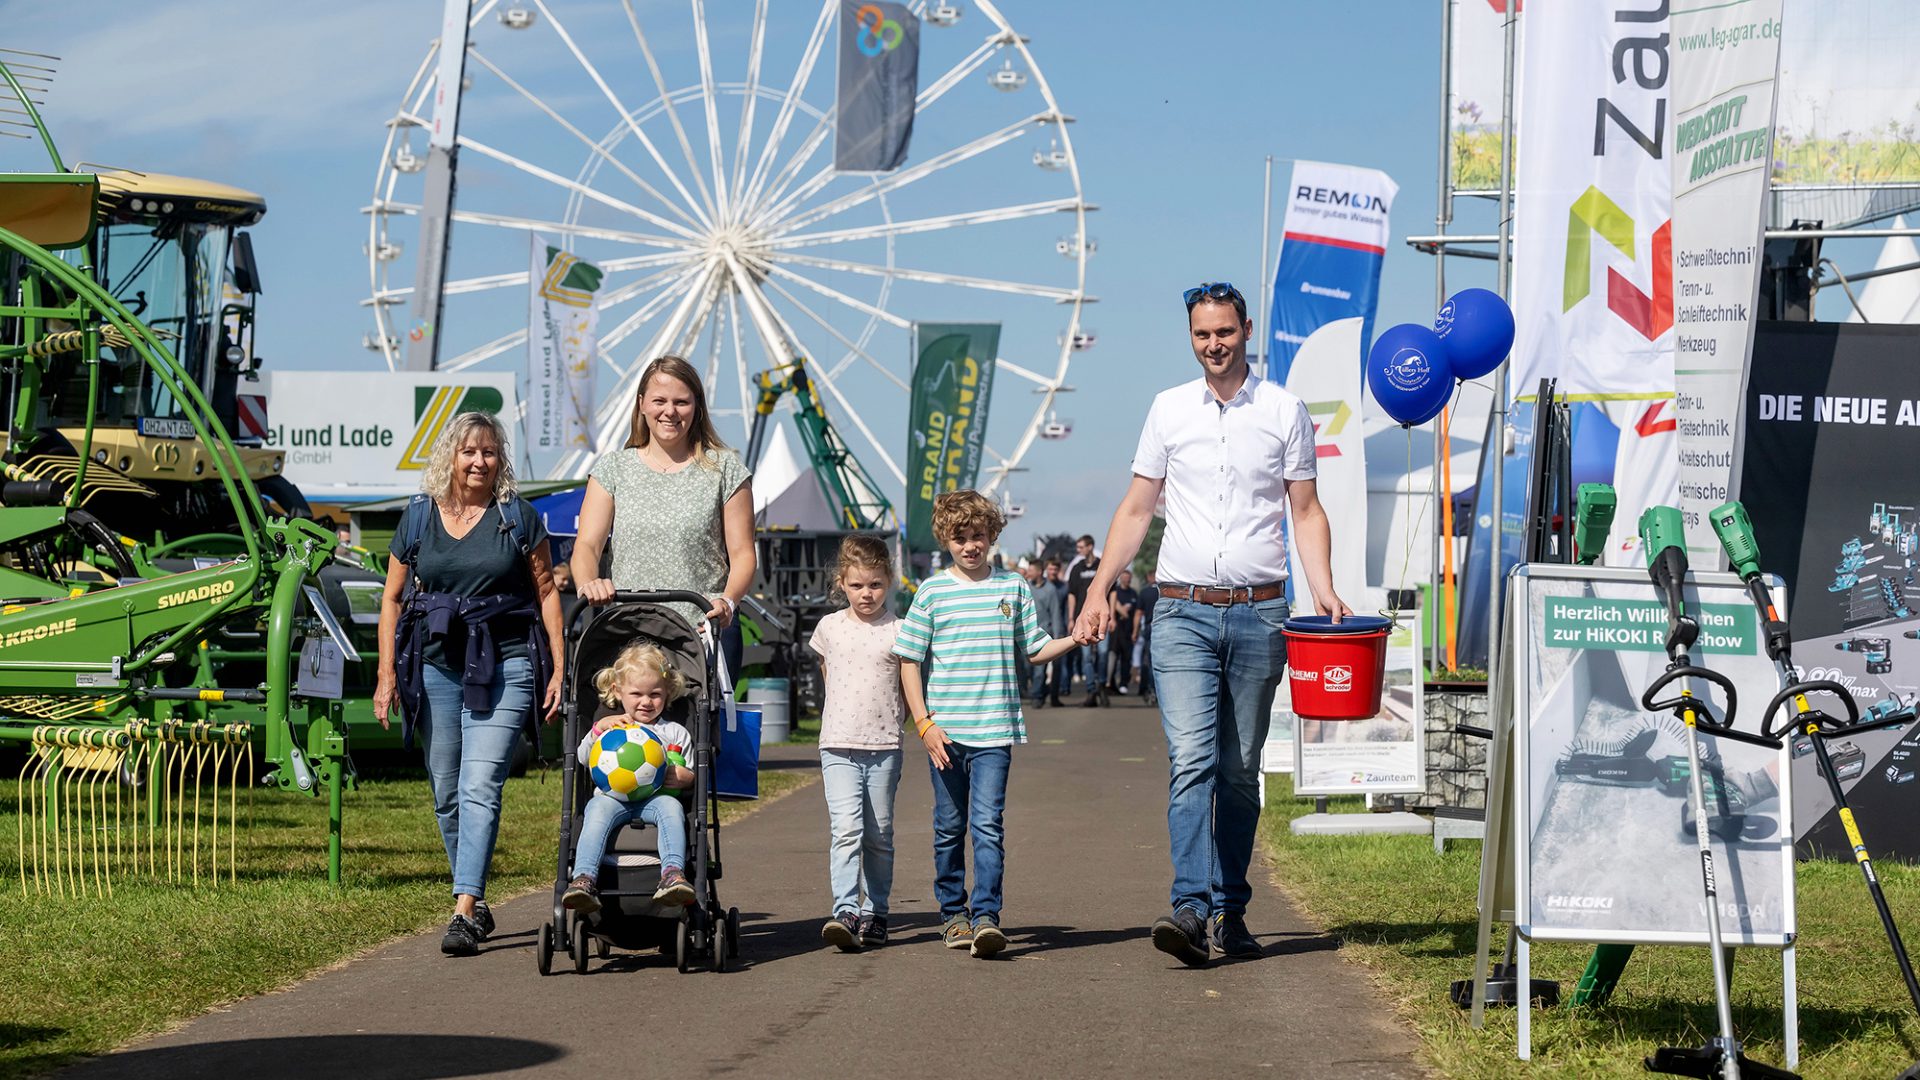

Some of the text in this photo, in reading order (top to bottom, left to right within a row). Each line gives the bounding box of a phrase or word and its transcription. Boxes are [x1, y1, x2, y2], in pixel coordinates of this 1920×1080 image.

[1689, 126, 1768, 183] AUSSTATTE
[1293, 204, 1322, 216] Immer
[1296, 185, 1388, 214] REMON
[1679, 246, 1756, 268] Schweißtechni
[1704, 283, 1714, 296] u.
[542, 346, 552, 379] und
[539, 384, 551, 447] Bressel
[1758, 394, 1803, 422] DIE
[1813, 396, 1888, 426] NEUE
[291, 424, 332, 447] und
[339, 424, 393, 447] Lade
[292, 451, 332, 464] GmbH
[920, 410, 946, 501] BRAND
[157, 579, 235, 610] SWADRO
[1553, 604, 1623, 623] Herzlich
[1626, 607, 1735, 627] Willkmen
[5, 617, 78, 647] KRONE
[1552, 627, 1743, 649] zur HiKOKI Rshow
[1366, 772, 1417, 783] Zaunteam
[1547, 894, 1614, 909] HiKOKI
